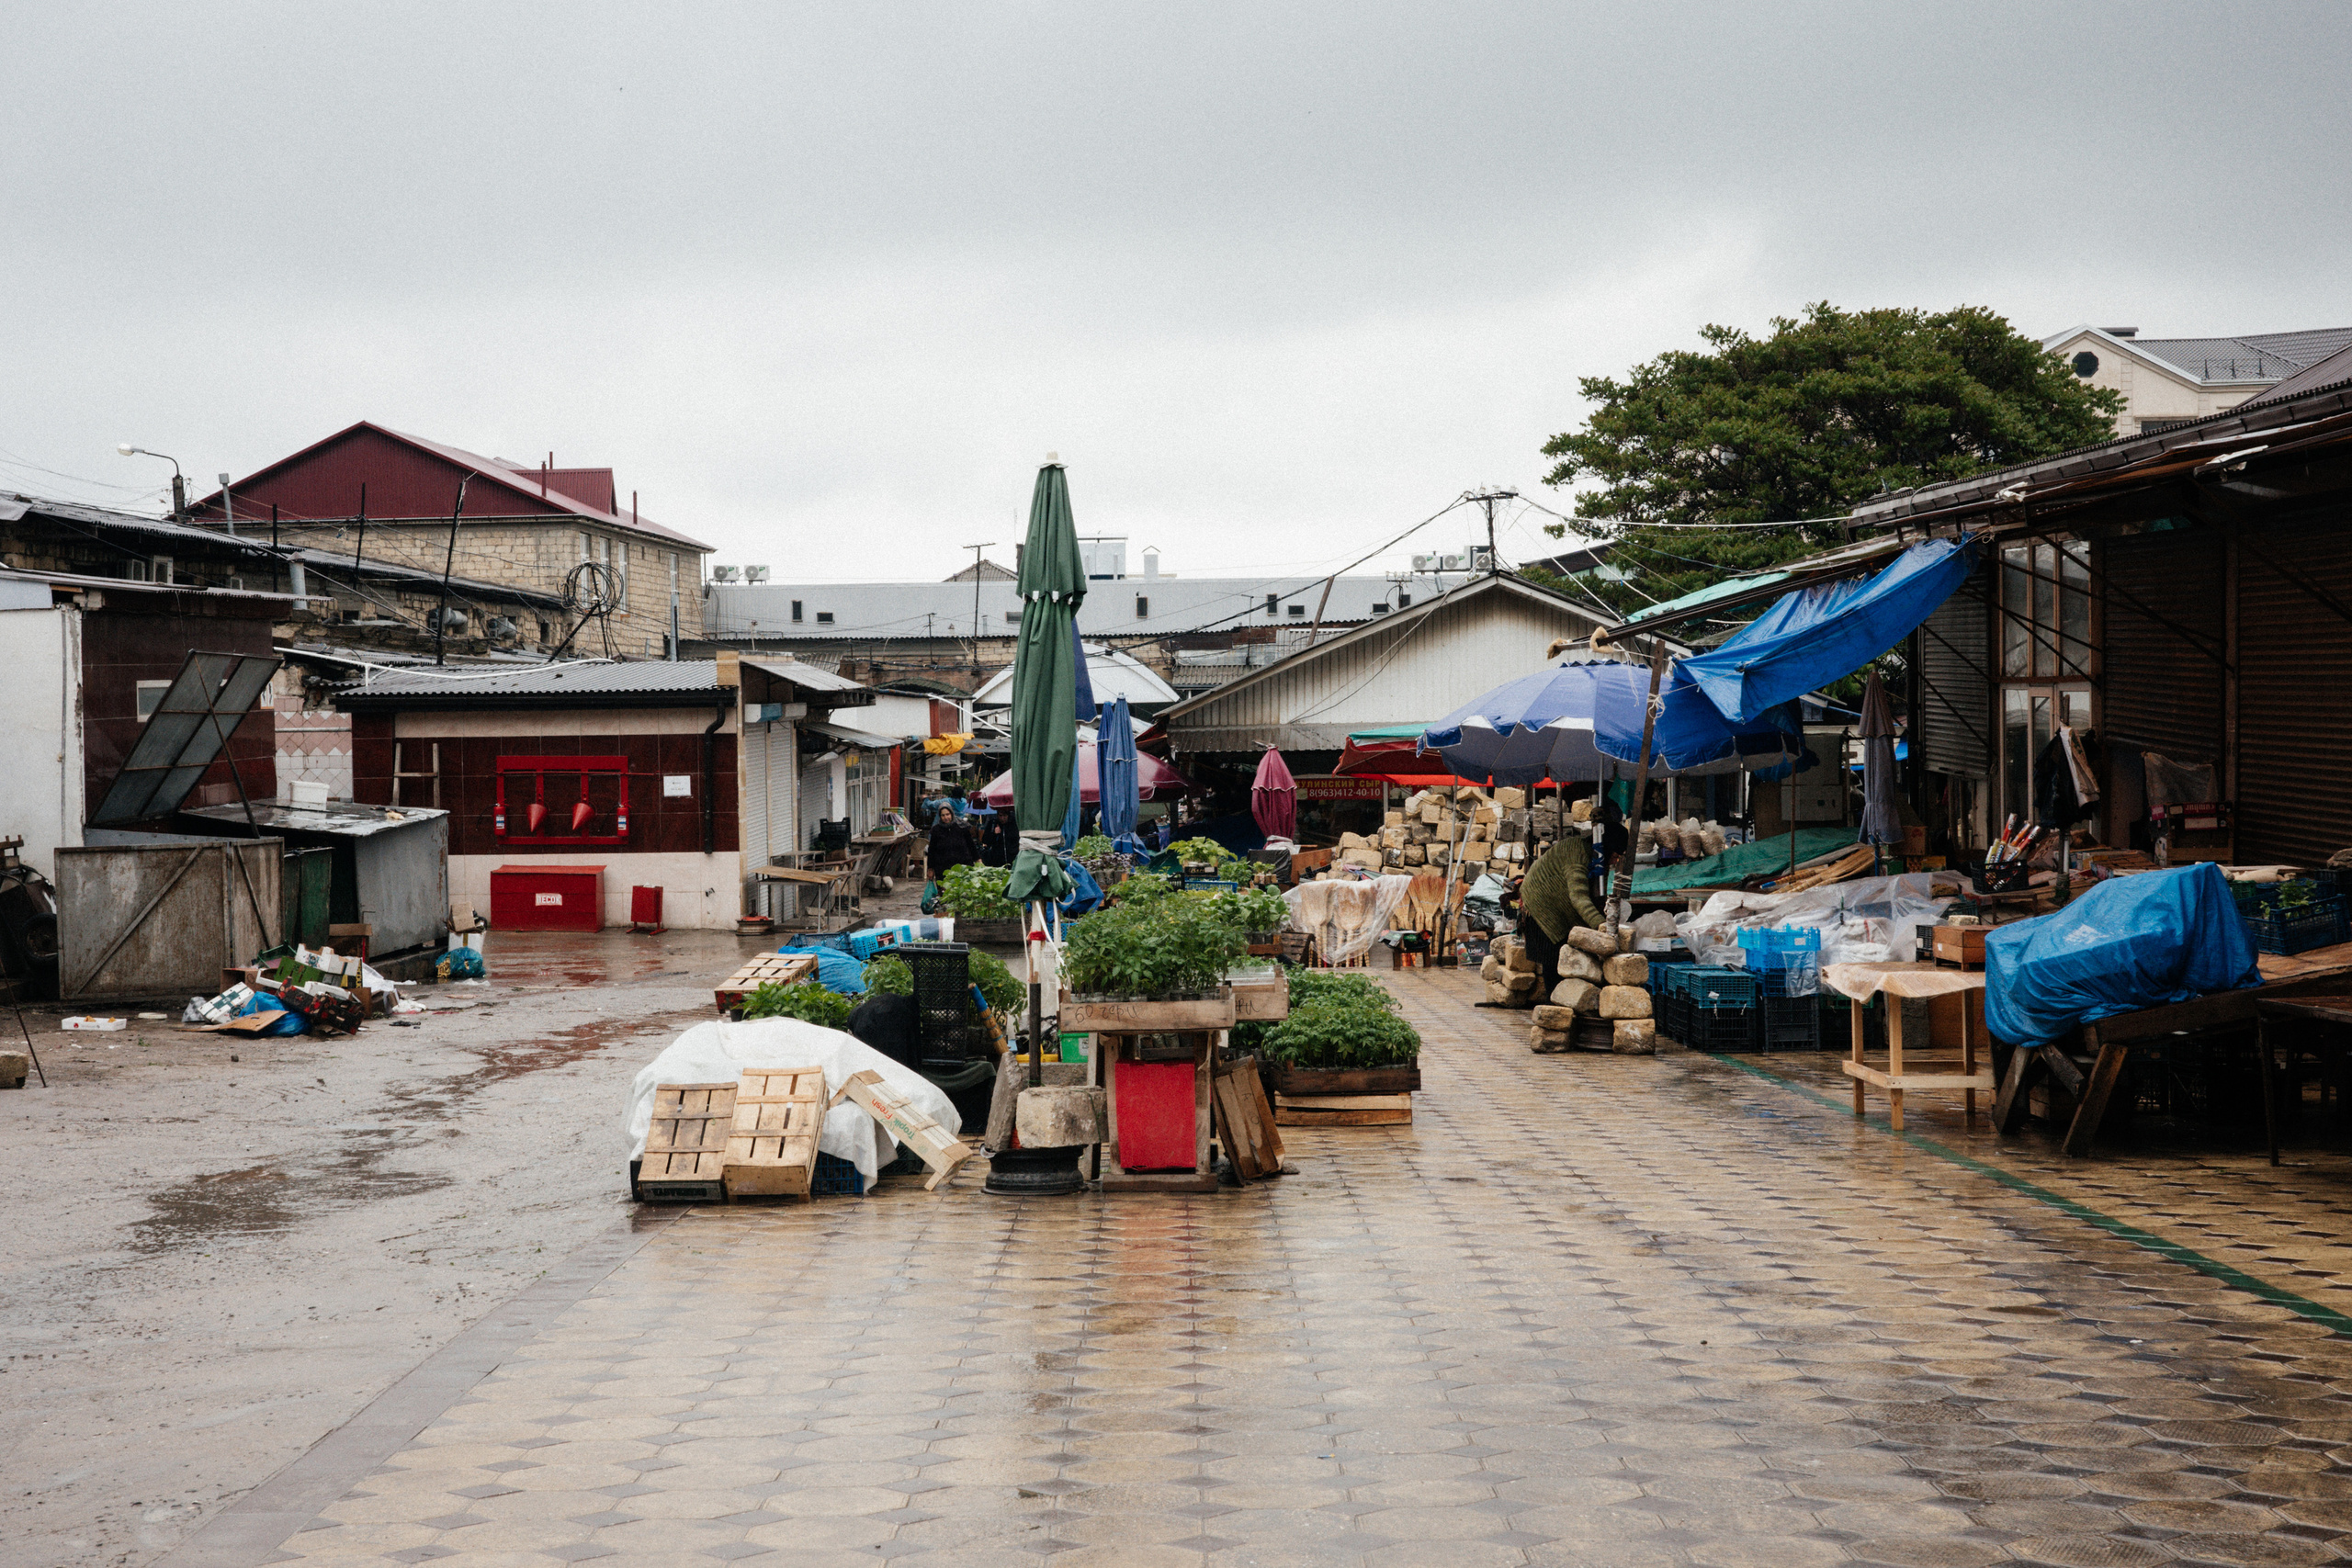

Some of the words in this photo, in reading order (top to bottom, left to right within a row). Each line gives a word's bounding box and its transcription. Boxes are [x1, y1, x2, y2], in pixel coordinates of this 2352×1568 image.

[1360, 780, 1381, 788] СЫР
[1309, 788, 1381, 797] 8(963)412-40-10
[537, 896, 560, 904] ПЕСОК
[871, 1099, 893, 1120] Fresh
[893, 1118, 915, 1140] Tropik
